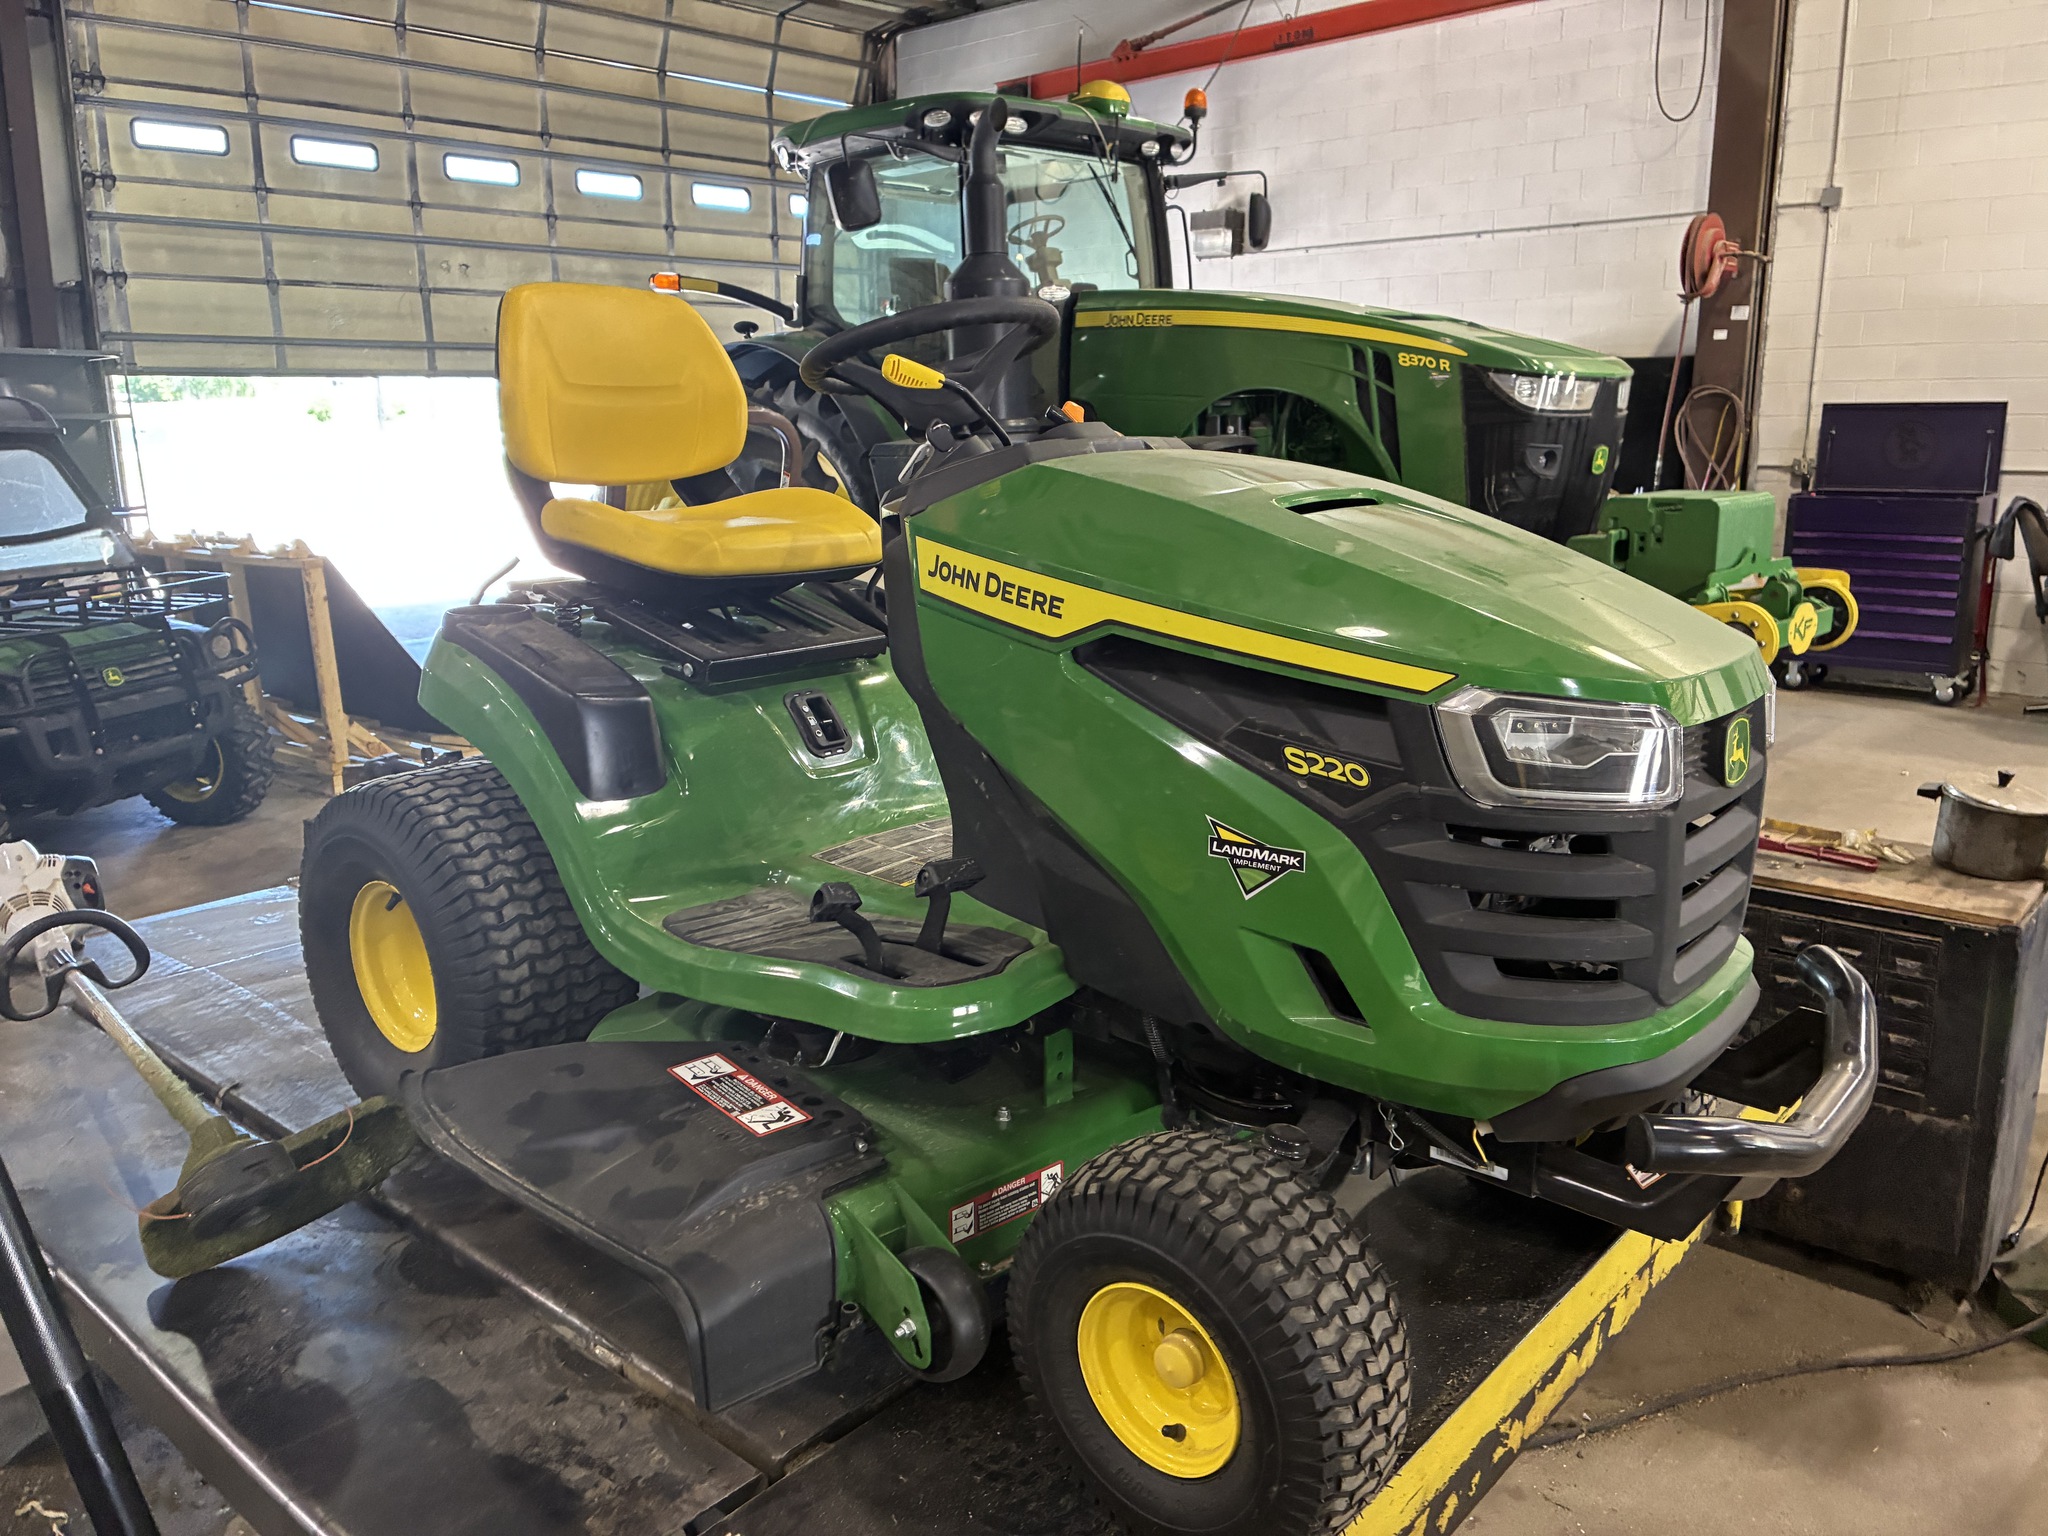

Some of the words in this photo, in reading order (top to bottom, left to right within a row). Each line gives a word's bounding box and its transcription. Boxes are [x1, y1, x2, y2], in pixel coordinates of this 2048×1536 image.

[1104, 312, 1134, 327] JOHN
[1136, 312, 1173, 326] DEERE
[1397, 352, 1437, 369] 8370
[1439, 358, 1451, 372] R
[927, 554, 981, 593] JOHN
[984, 571, 1065, 620] DEERE
[1283, 745, 1370, 788] S220
[1212, 840, 1301, 867] LANDMARK
[1233, 857, 1282, 873] IMPLEMENT
[744, 1078, 778, 1101] DANGER
[997, 1177, 1026, 1195] DANGER
